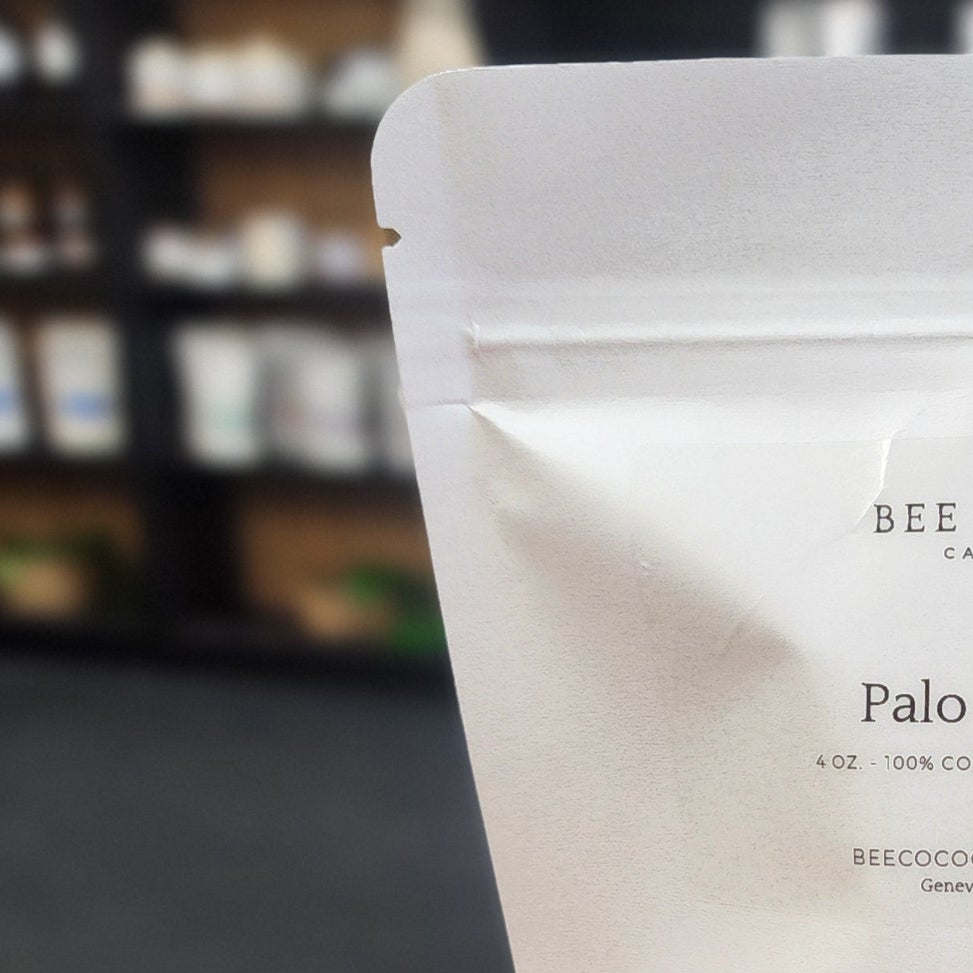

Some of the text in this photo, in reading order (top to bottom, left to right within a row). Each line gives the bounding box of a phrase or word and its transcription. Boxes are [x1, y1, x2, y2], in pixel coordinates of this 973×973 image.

[873, 502, 958, 534] BEE
[860, 678, 967, 724] Palo
[815, 754, 827, 769] 4
[831, 754, 863, 771] OZ.
[883, 754, 934, 772] 100%
